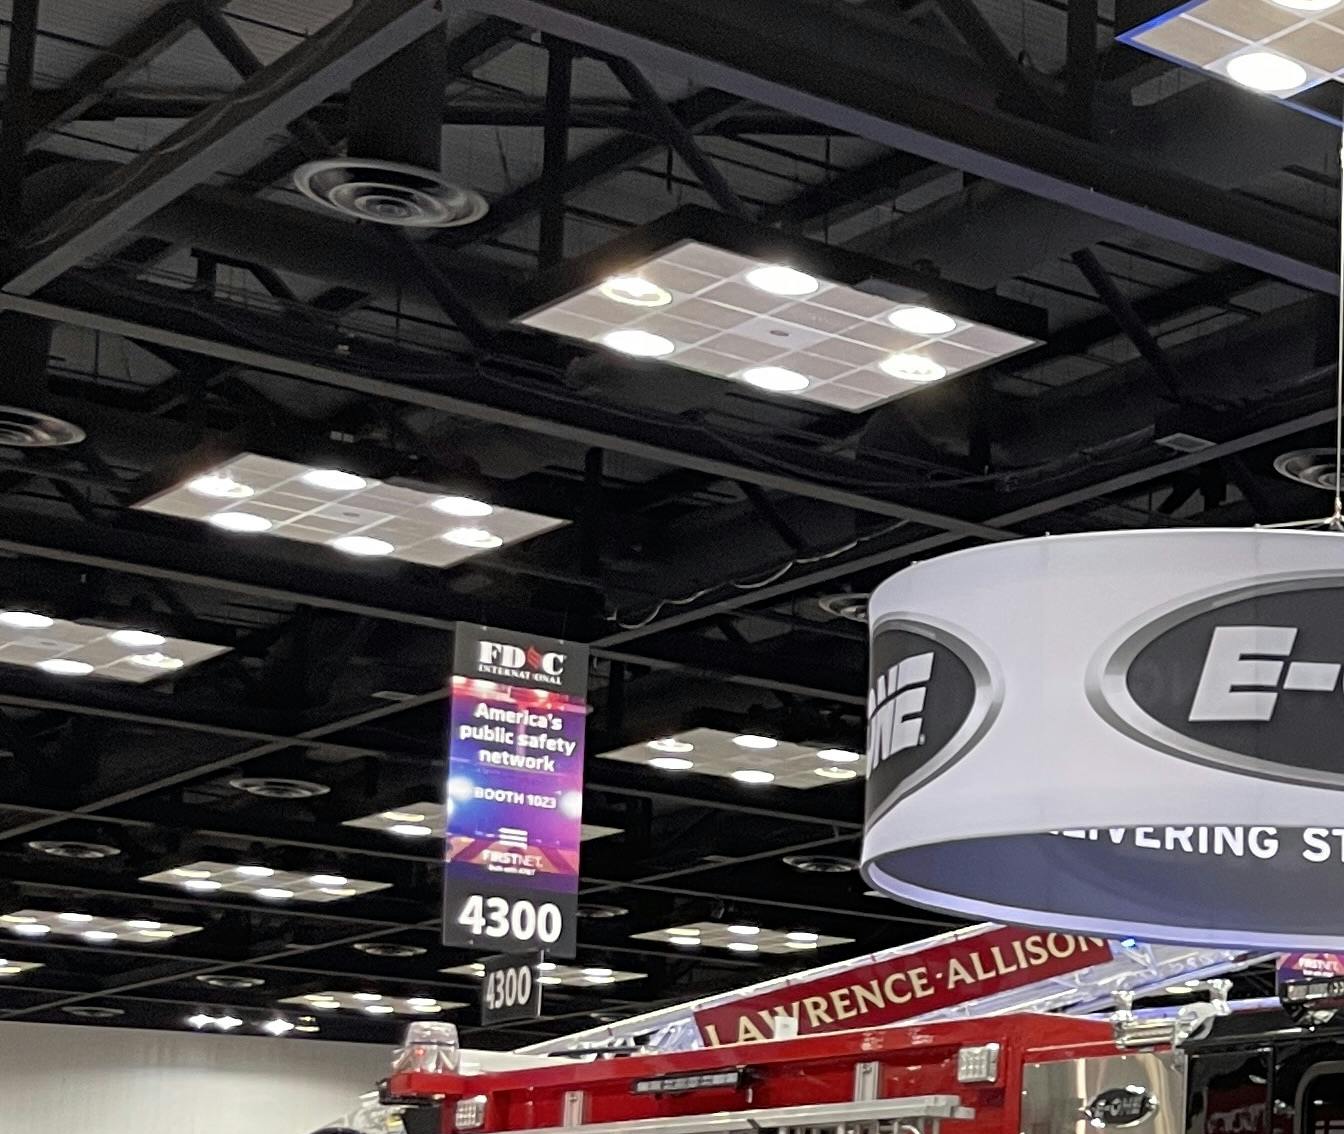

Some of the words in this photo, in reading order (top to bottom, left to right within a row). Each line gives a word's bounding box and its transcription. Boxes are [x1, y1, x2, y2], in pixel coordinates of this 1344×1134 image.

[478, 664, 562, 685] INTERNATIONAL
[474, 702, 563, 731] America's
[459, 725, 514, 745] public
[517, 734, 576, 757] safety
[478, 749, 555, 772] network
[474, 787, 524, 804] BOOTH
[526, 794, 557, 809] 1023
[458, 895, 563, 943] 4300
[486, 965, 532, 1010] 4300
